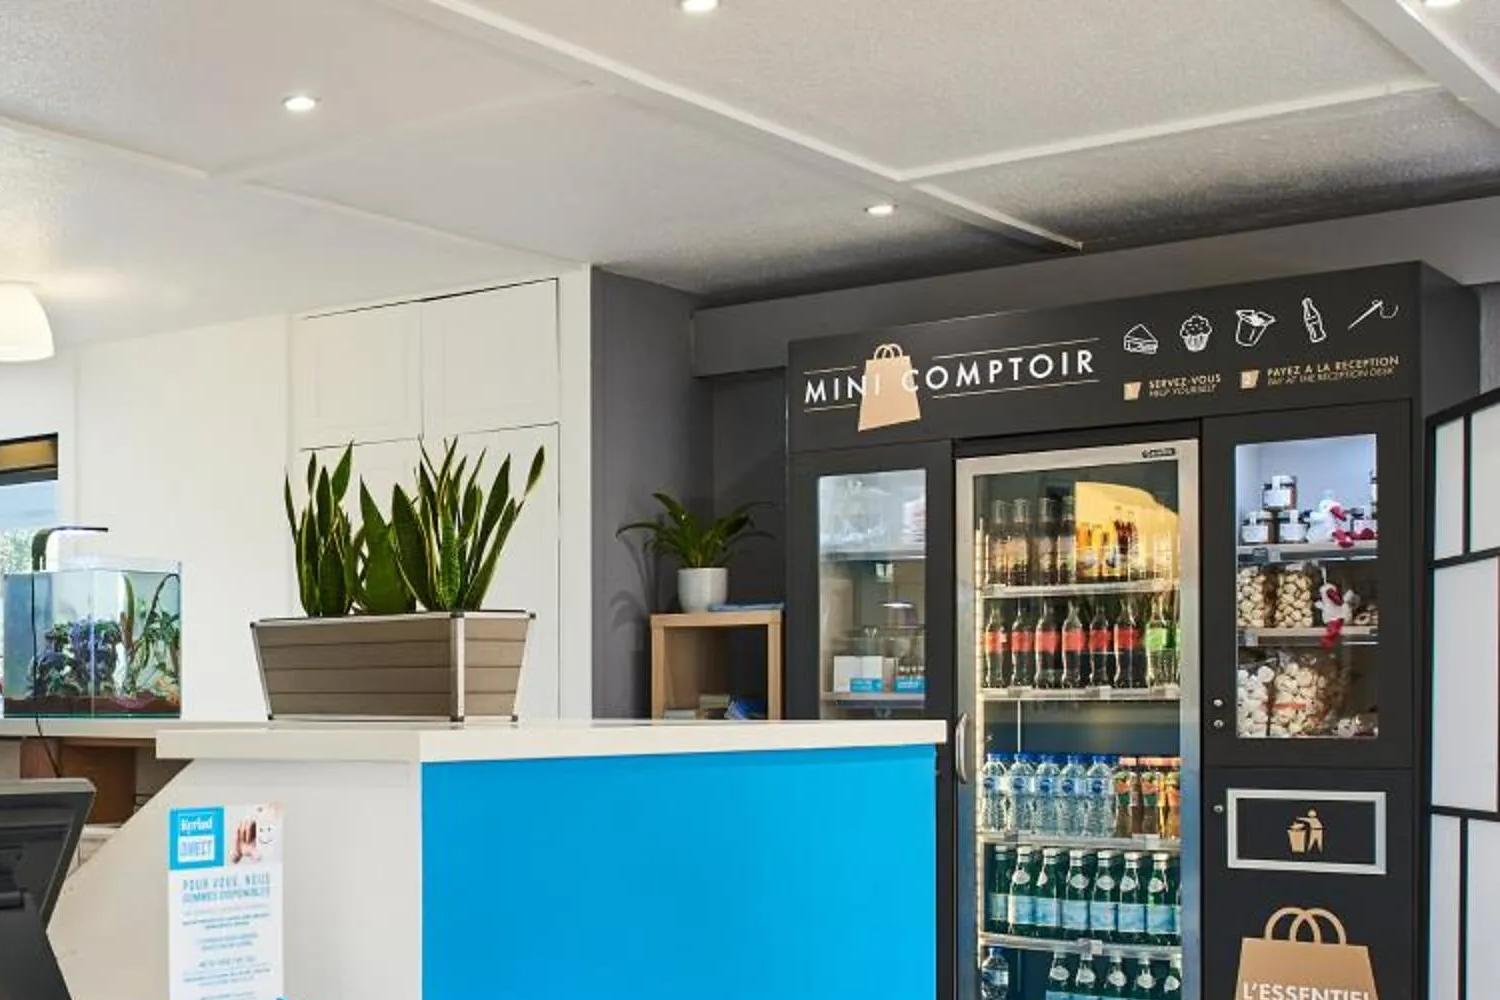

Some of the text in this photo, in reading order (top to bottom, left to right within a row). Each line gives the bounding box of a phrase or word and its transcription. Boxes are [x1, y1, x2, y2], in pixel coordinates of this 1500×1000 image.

[804, 349, 1094, 404] MINI COMPTOIR
[1317, 362, 1330, 373] LA
